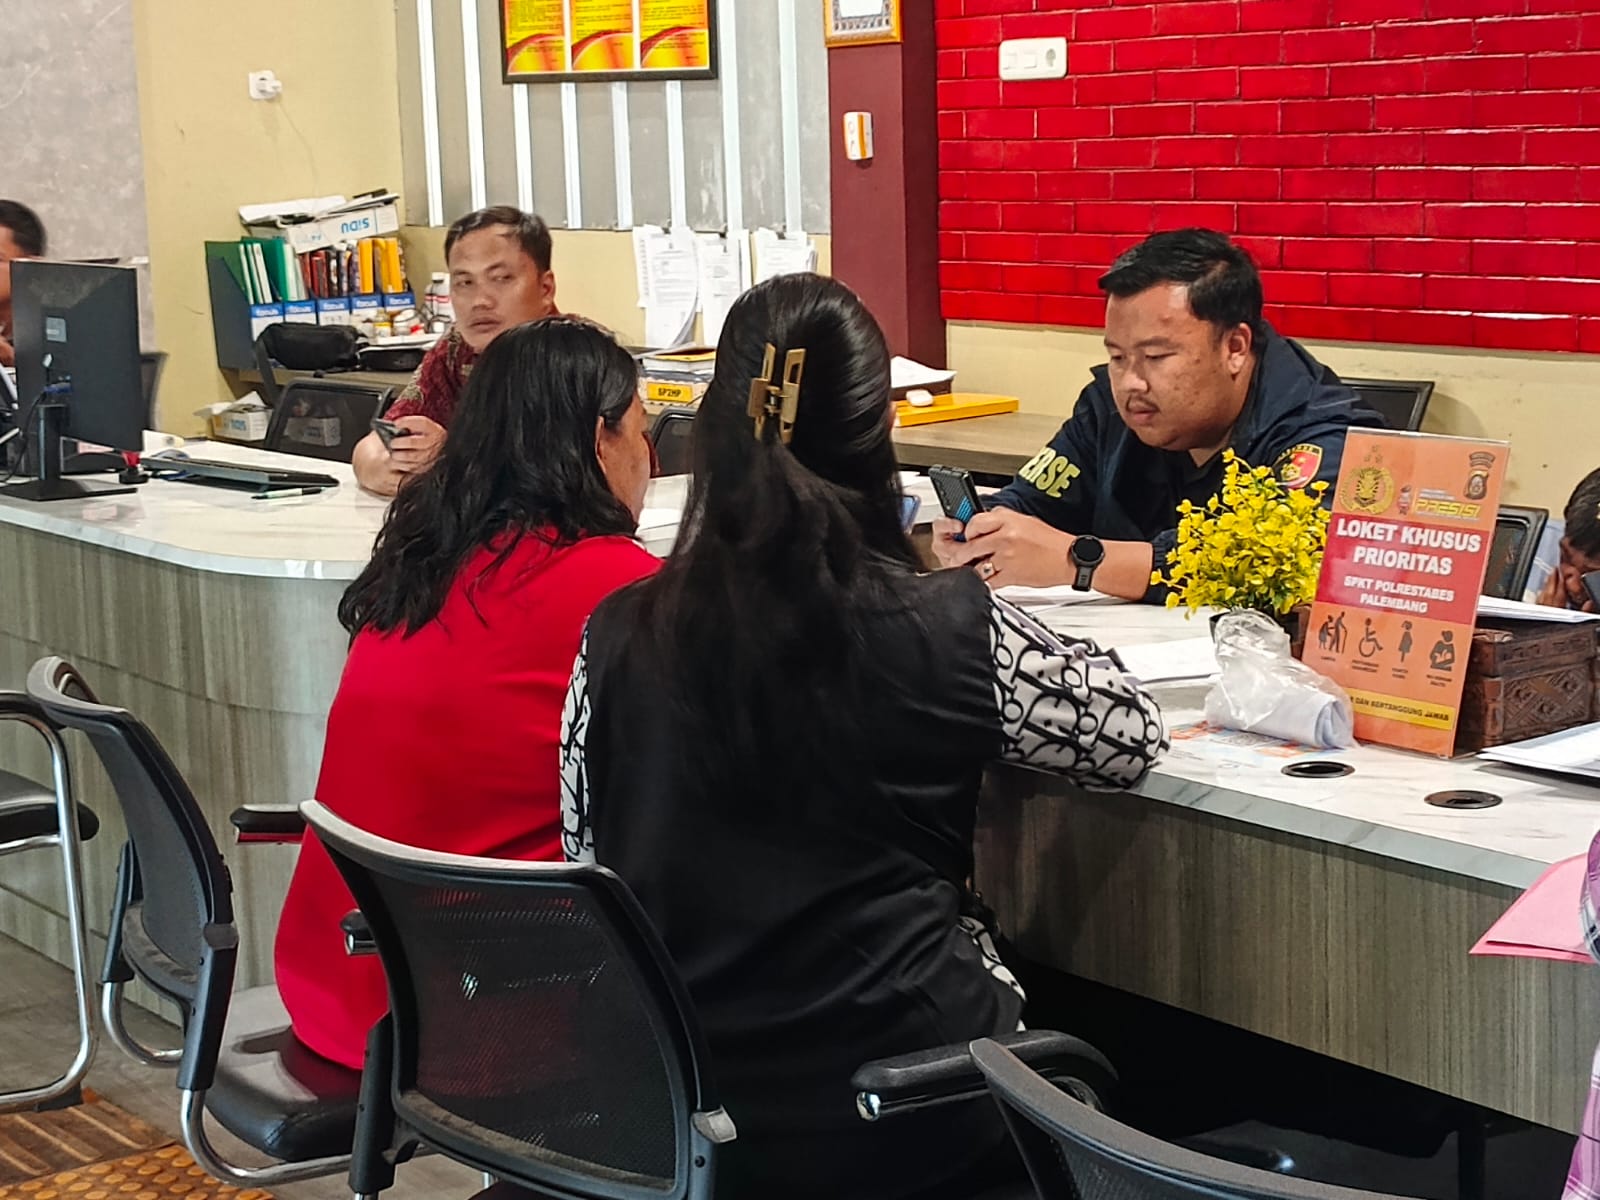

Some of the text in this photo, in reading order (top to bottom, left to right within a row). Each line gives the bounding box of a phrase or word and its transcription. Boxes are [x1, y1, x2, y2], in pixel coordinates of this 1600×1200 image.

[1337, 518, 1482, 553] LOKET KHUSUS
[1353, 546, 1453, 575] PRIORITAS
[1344, 575, 1455, 602] SPKT POLRESTABES
[1360, 593, 1428, 614] PALEMBANG
[1371, 700, 1423, 717] BERTANGGUNG
